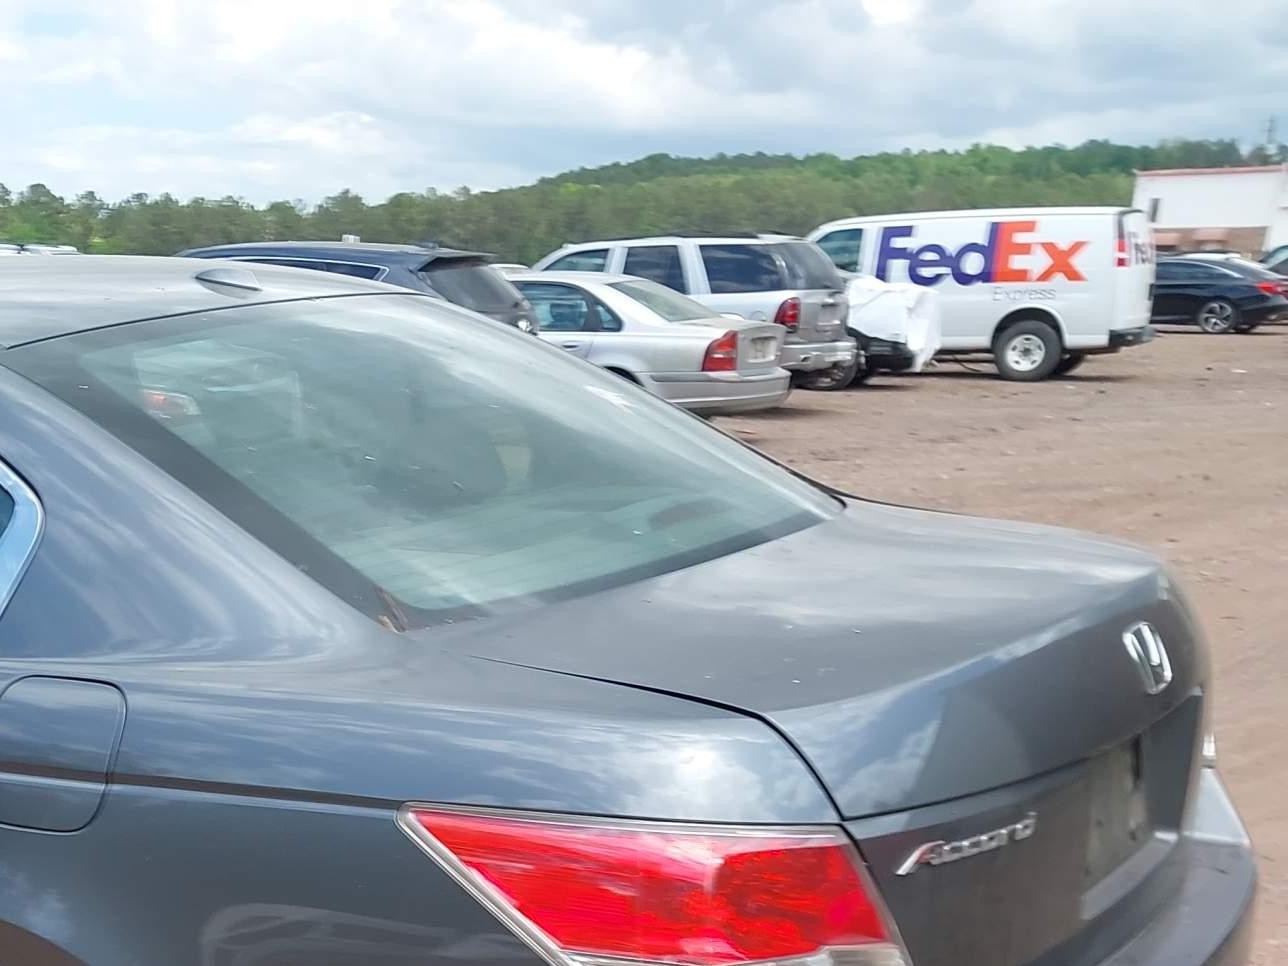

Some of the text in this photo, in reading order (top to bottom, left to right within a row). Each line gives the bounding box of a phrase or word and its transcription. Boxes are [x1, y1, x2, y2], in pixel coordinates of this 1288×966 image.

[876, 219, 1090, 286] FedEx
[992, 286, 1057, 302] Express
[895, 811, 1038, 876] Accord
